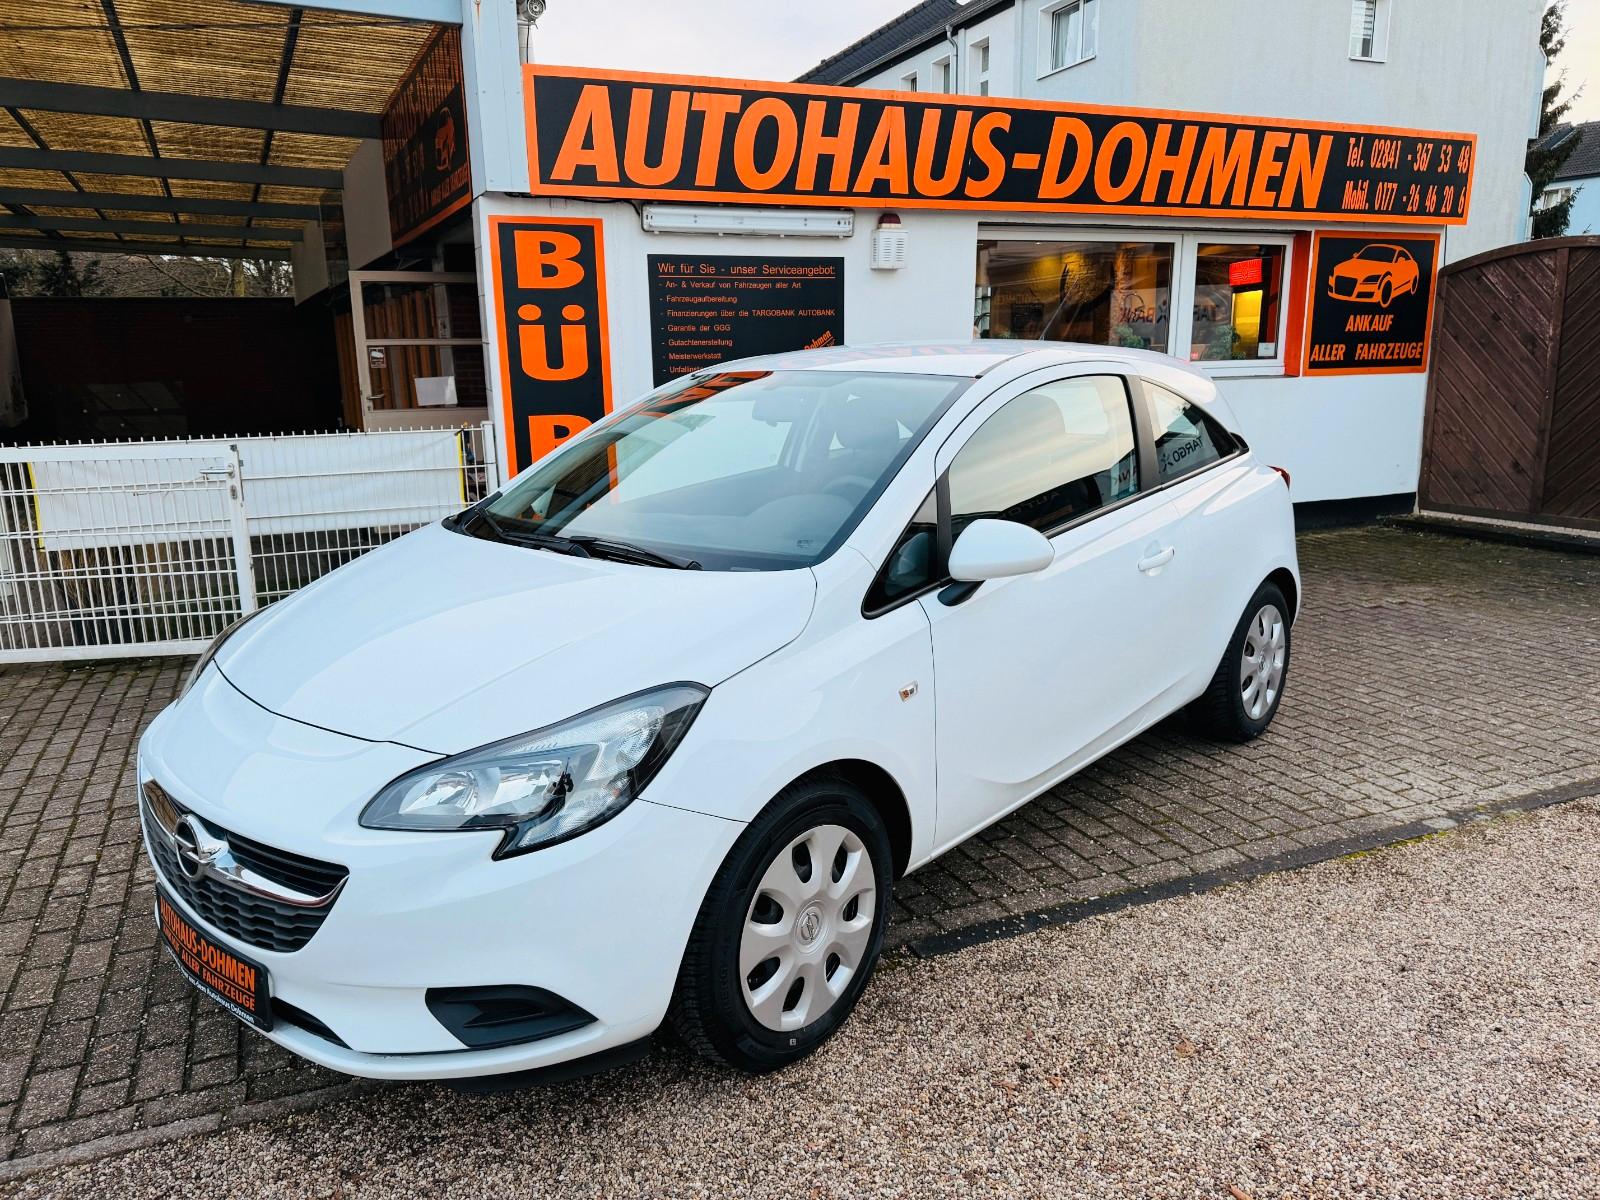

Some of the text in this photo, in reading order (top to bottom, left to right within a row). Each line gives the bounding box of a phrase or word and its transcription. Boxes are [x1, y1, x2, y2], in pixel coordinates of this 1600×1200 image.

[550, 84, 1333, 209] AUTOHAUS-DOHMEN
[1346, 136, 1365, 168] Tel.
[1370, 138, 1402, 169] 02841
[1437, 144, 1453, 173] 53
[1457, 145, 1471, 174] 48
[1341, 179, 1369, 210] Mobil.
[1374, 181, 1399, 211] 0177
[1424, 184, 1438, 213] 46
[1440, 184, 1455, 214] 20
[657, 262, 676, 273] Wir
[680, 262, 694, 273] für
[699, 263, 716, 274] Sie
[730, 265, 758, 274] unser
[762, 264, 836, 277] Serviceangebot:
[734, 281, 772, 290] Fahrzeugen
[775, 281, 789, 289] aller
[792, 281, 802, 289] Art
[666, 295, 738, 304] Fahrzeugaufbereitung
[667, 309, 836, 318] Finanzierungen über die TARGOBANK AUTOBANK
[667, 324, 731, 332] Garantie der GGG
[1345, 314, 1394, 332] ANKAUF
[668, 338, 733, 347] Gutachtenerstellung
[668, 352, 722, 360] Meisterwerkstatt
[1310, 341, 1424, 362] ALLER FAHRZEUGE
[159, 895, 255, 993] AUTOHAUS-DOHMEN
[181, 949, 200, 976] ALLER
[202, 967, 255, 1012] FAHRZEUGE
